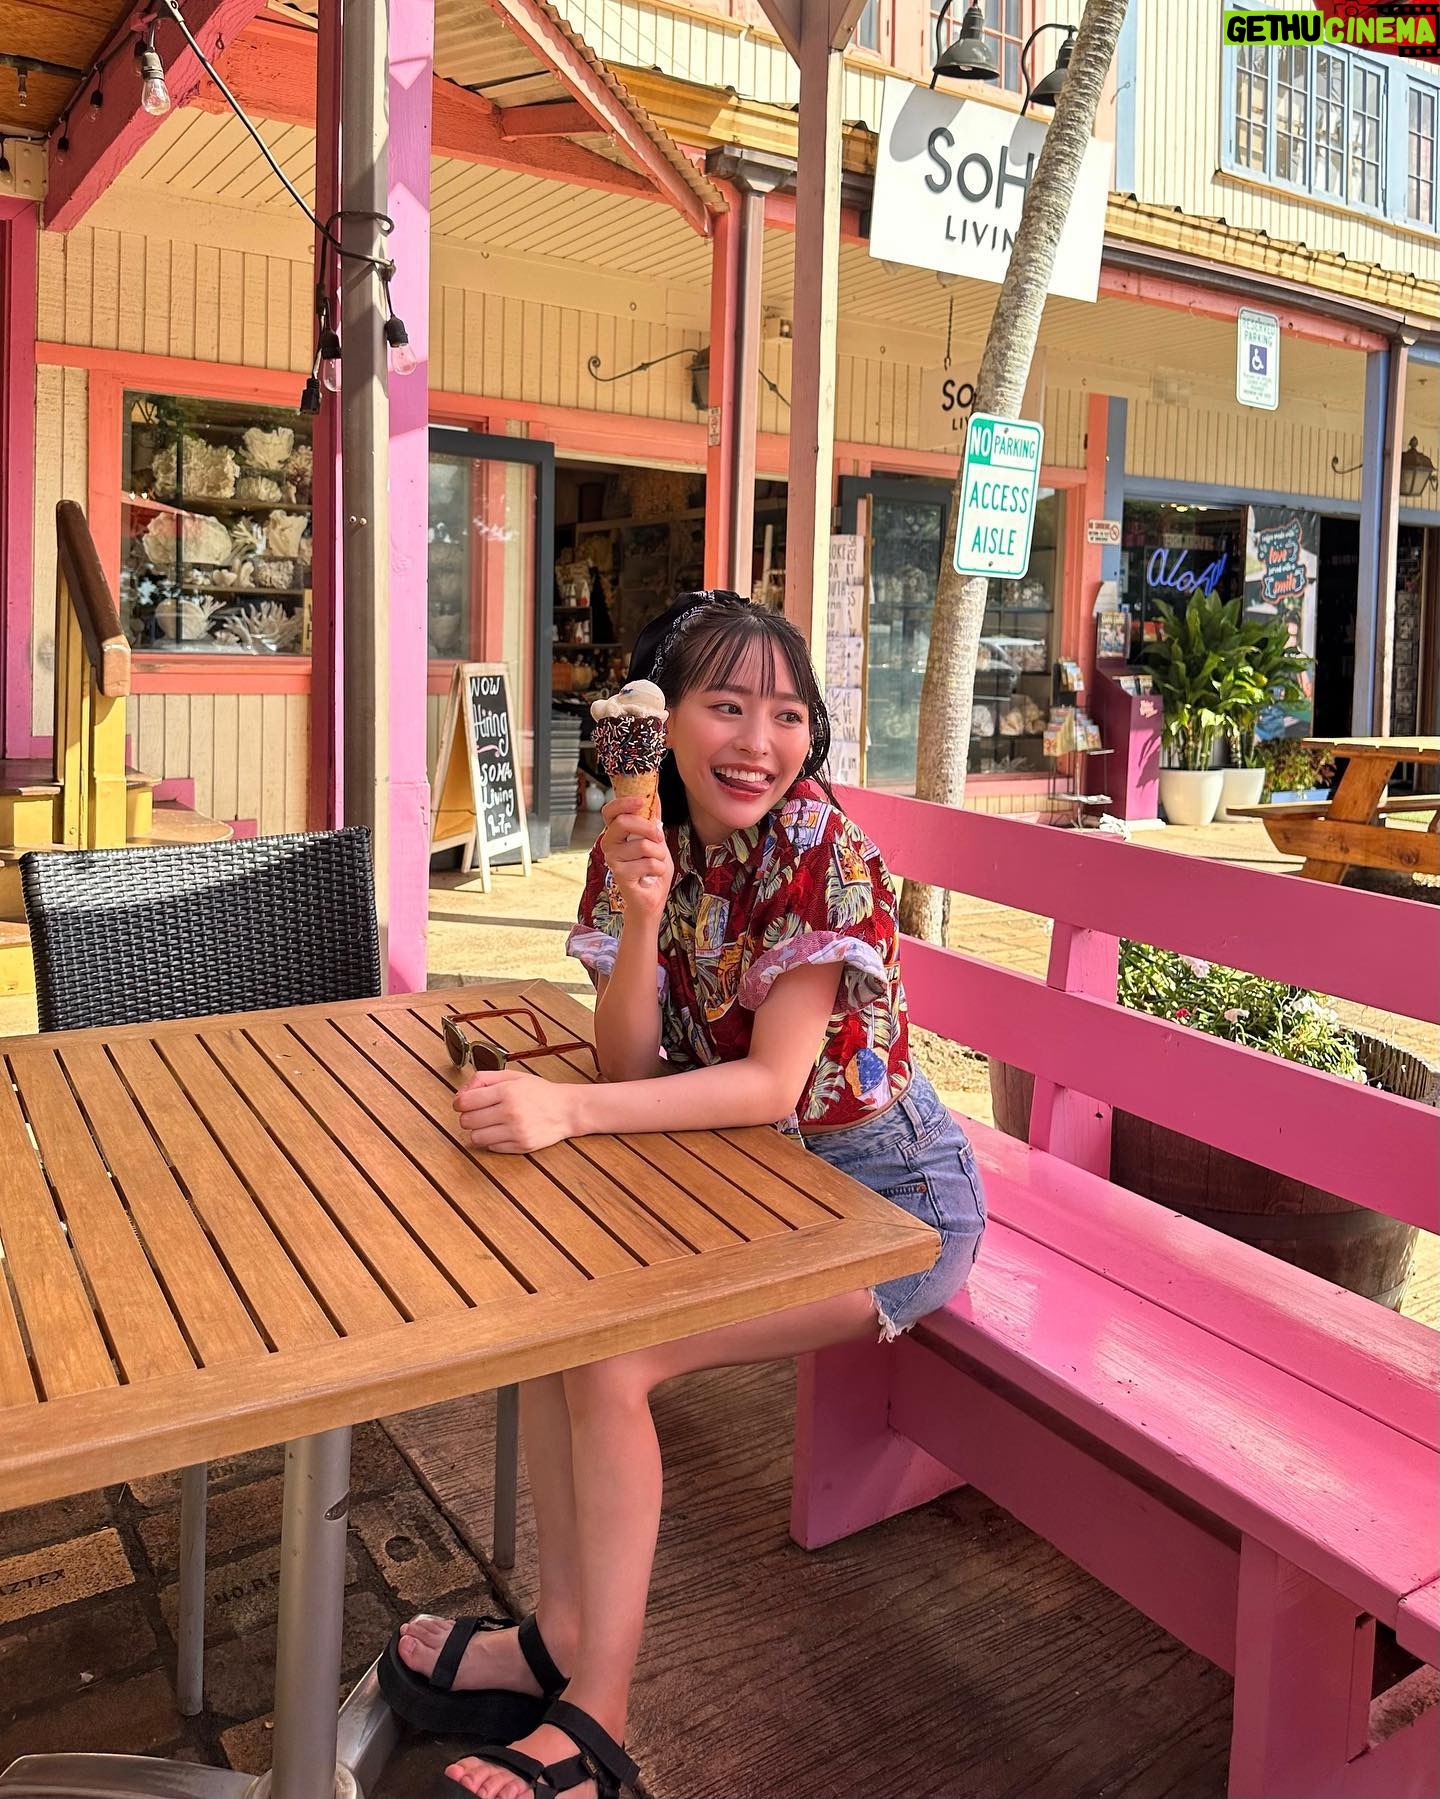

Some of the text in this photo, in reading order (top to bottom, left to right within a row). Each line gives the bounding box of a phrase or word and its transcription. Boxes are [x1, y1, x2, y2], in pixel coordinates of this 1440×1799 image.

[945, 215, 1018, 253] LIVIN
[1244, 330, 1273, 347] PARKING
[942, 379, 975, 411] SO
[970, 425, 1036, 460] NO PARKING
[969, 481, 1030, 514] ACCESS
[971, 525, 1017, 556] AISLE
[471, 677, 501, 697] NOW
[473, 704, 509, 757] Hiring
[482, 786, 515, 818] Living
